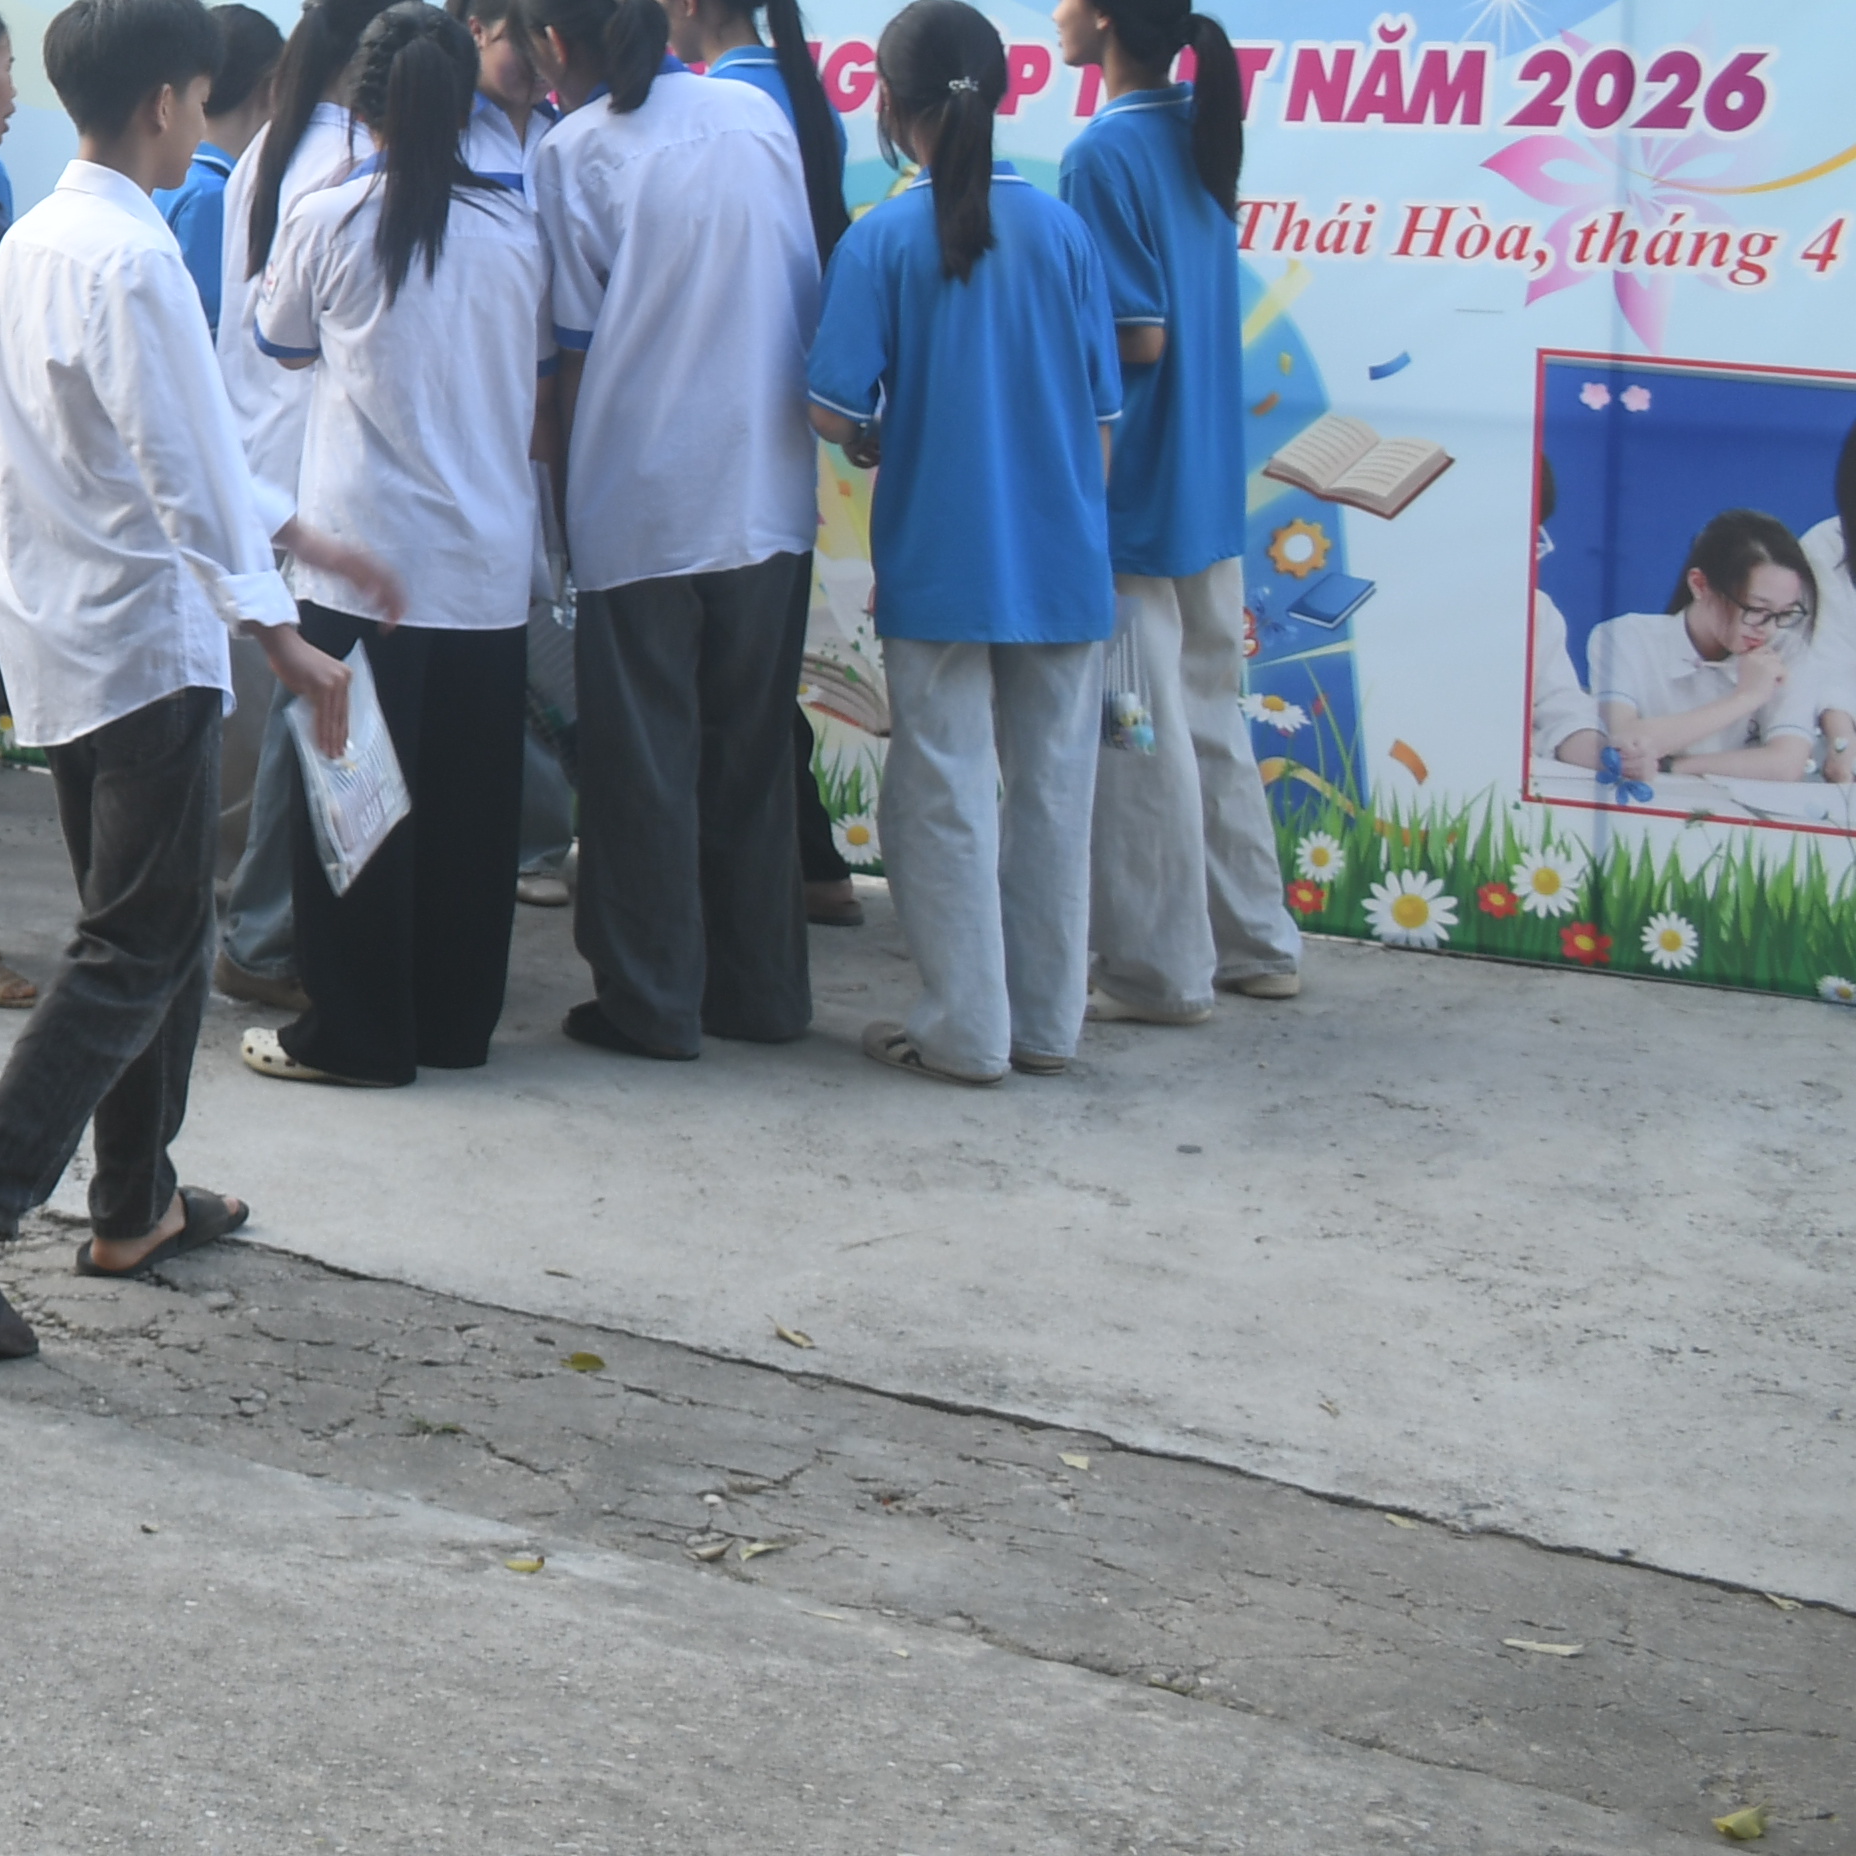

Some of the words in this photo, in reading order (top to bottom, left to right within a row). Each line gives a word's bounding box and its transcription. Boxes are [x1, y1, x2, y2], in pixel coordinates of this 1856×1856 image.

[1285, 23, 1487, 125] NĂM
[1504, 48, 1770, 133] 2026
[1236, 200, 1375, 256] Thái
[1390, 204, 1550, 274] Hòa,
[1574, 210, 1778, 287] tháng
[1799, 216, 1846, 274] 4
